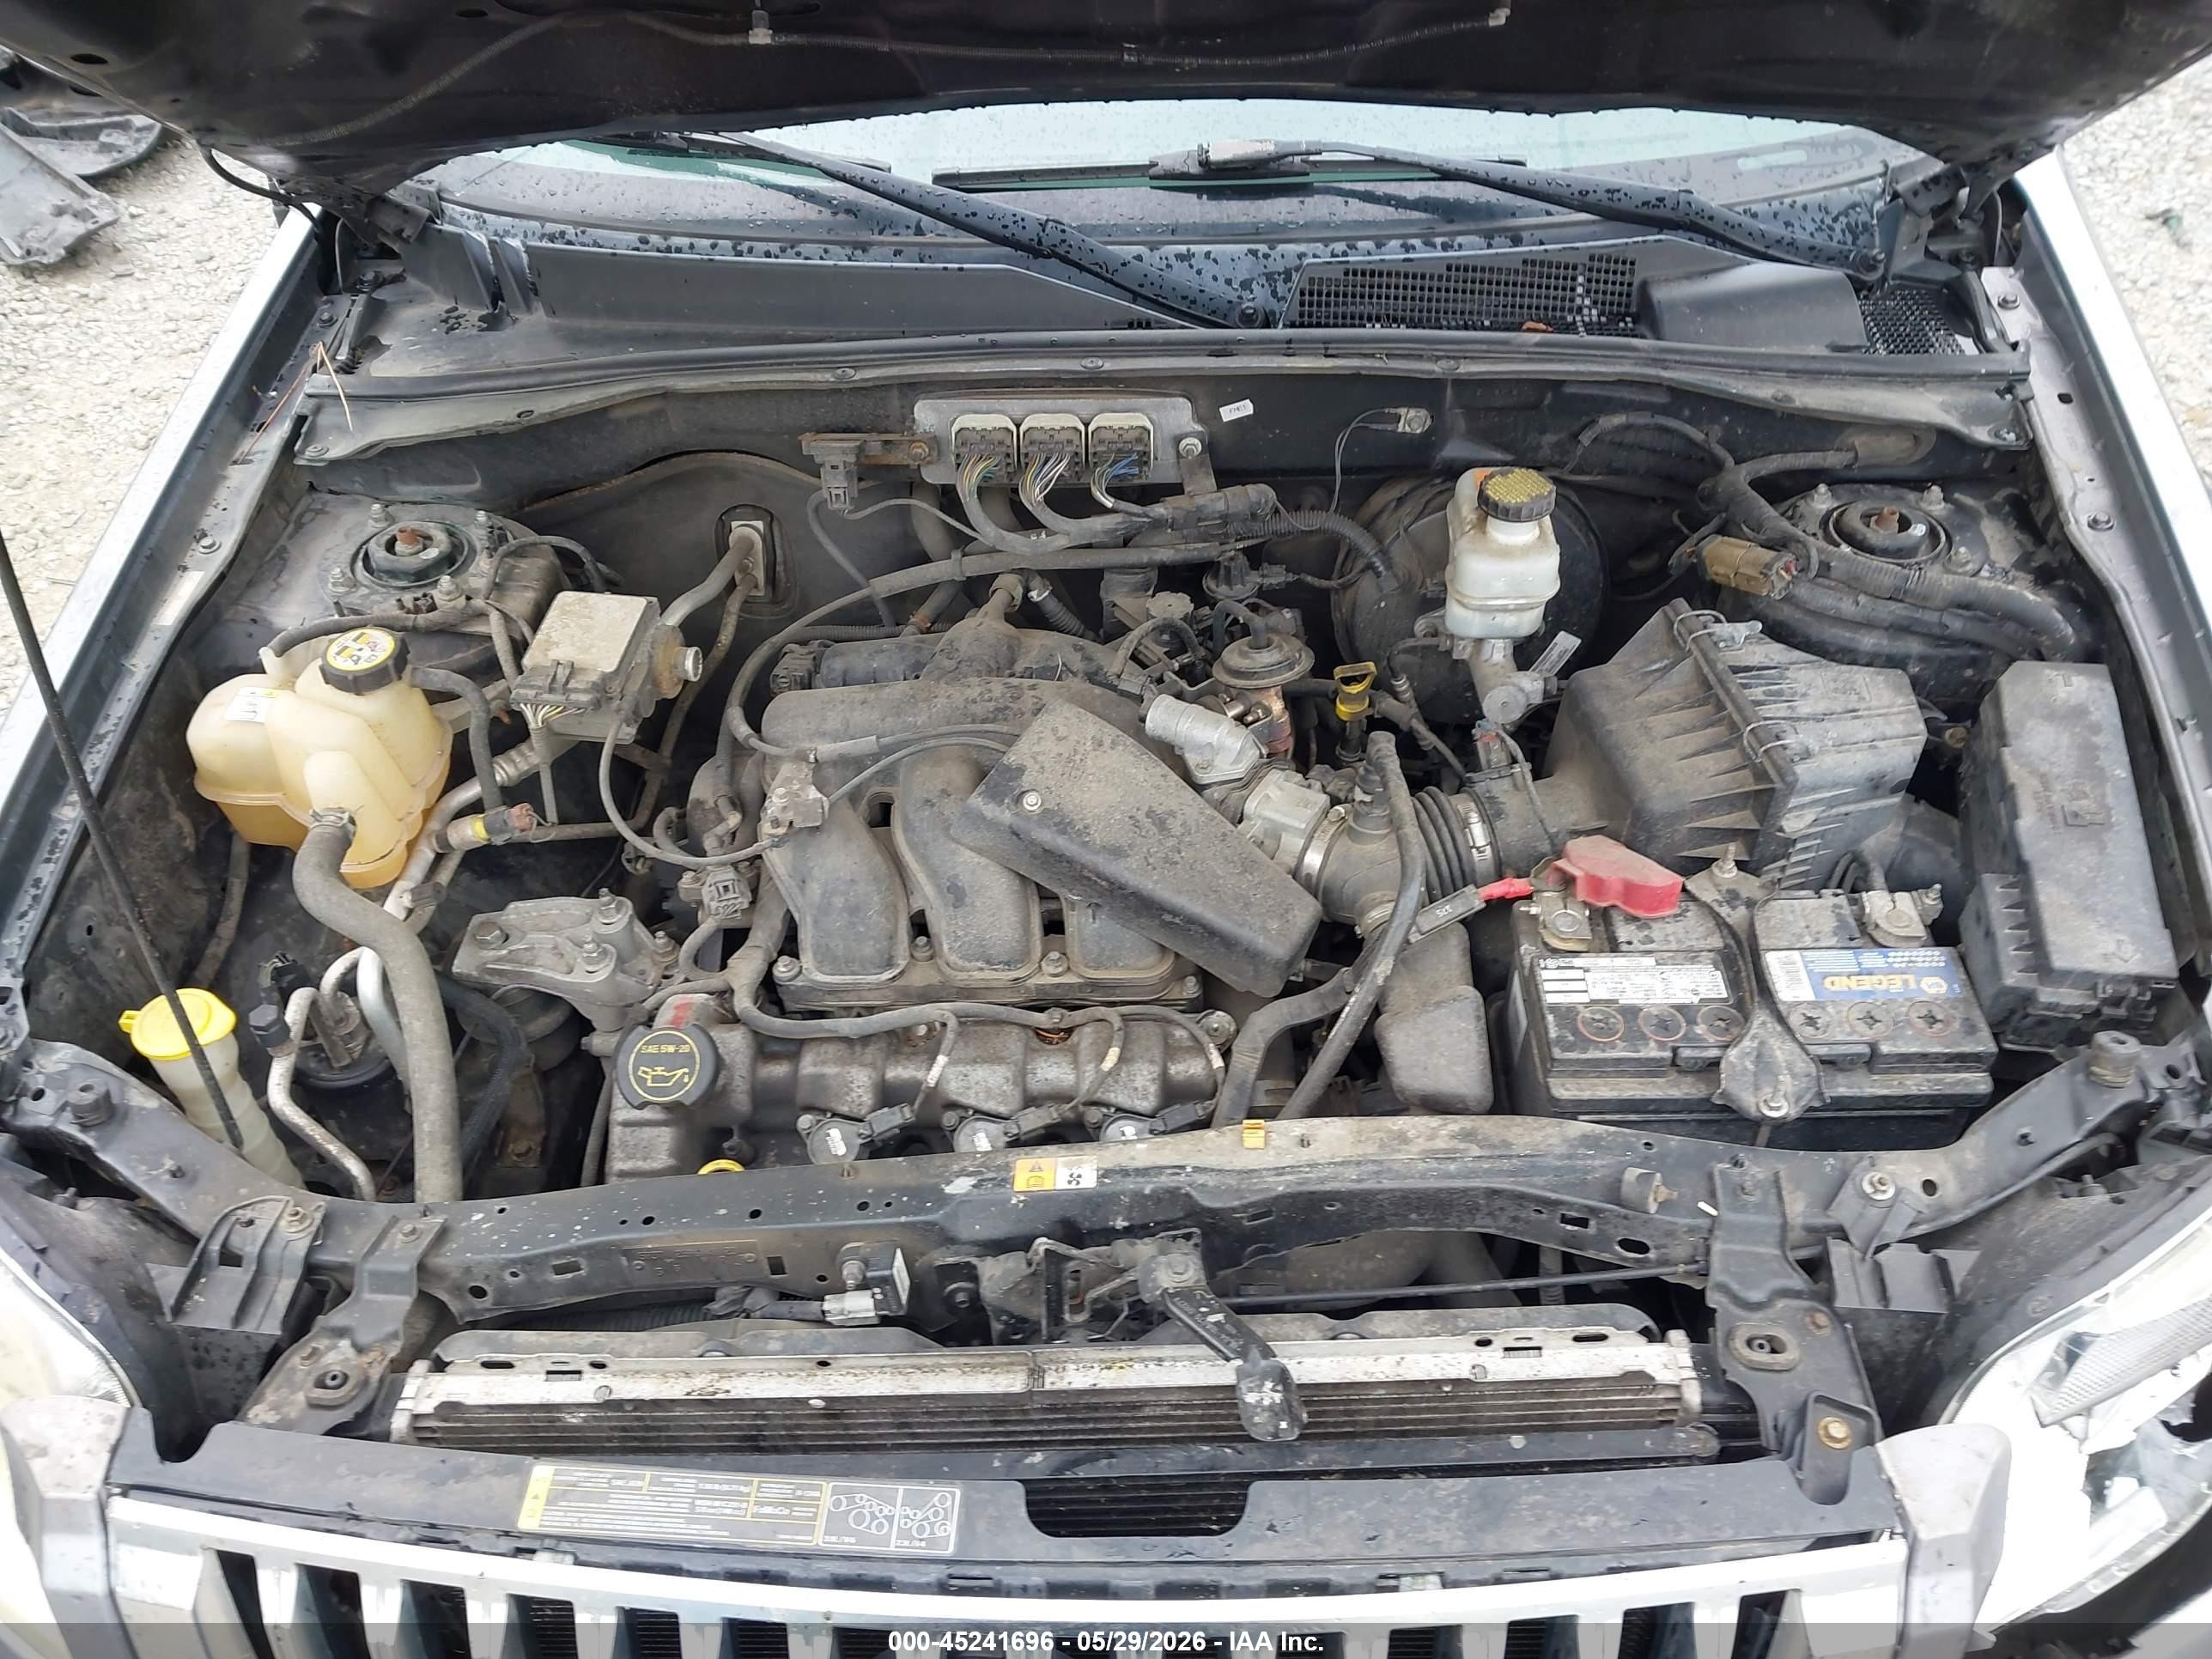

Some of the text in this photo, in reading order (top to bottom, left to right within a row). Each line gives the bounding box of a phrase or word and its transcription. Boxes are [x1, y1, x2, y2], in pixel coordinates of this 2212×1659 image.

[1822, 974, 1916, 991] LEGEND
[640, 1044, 691, 1054] SAE 5W-20
